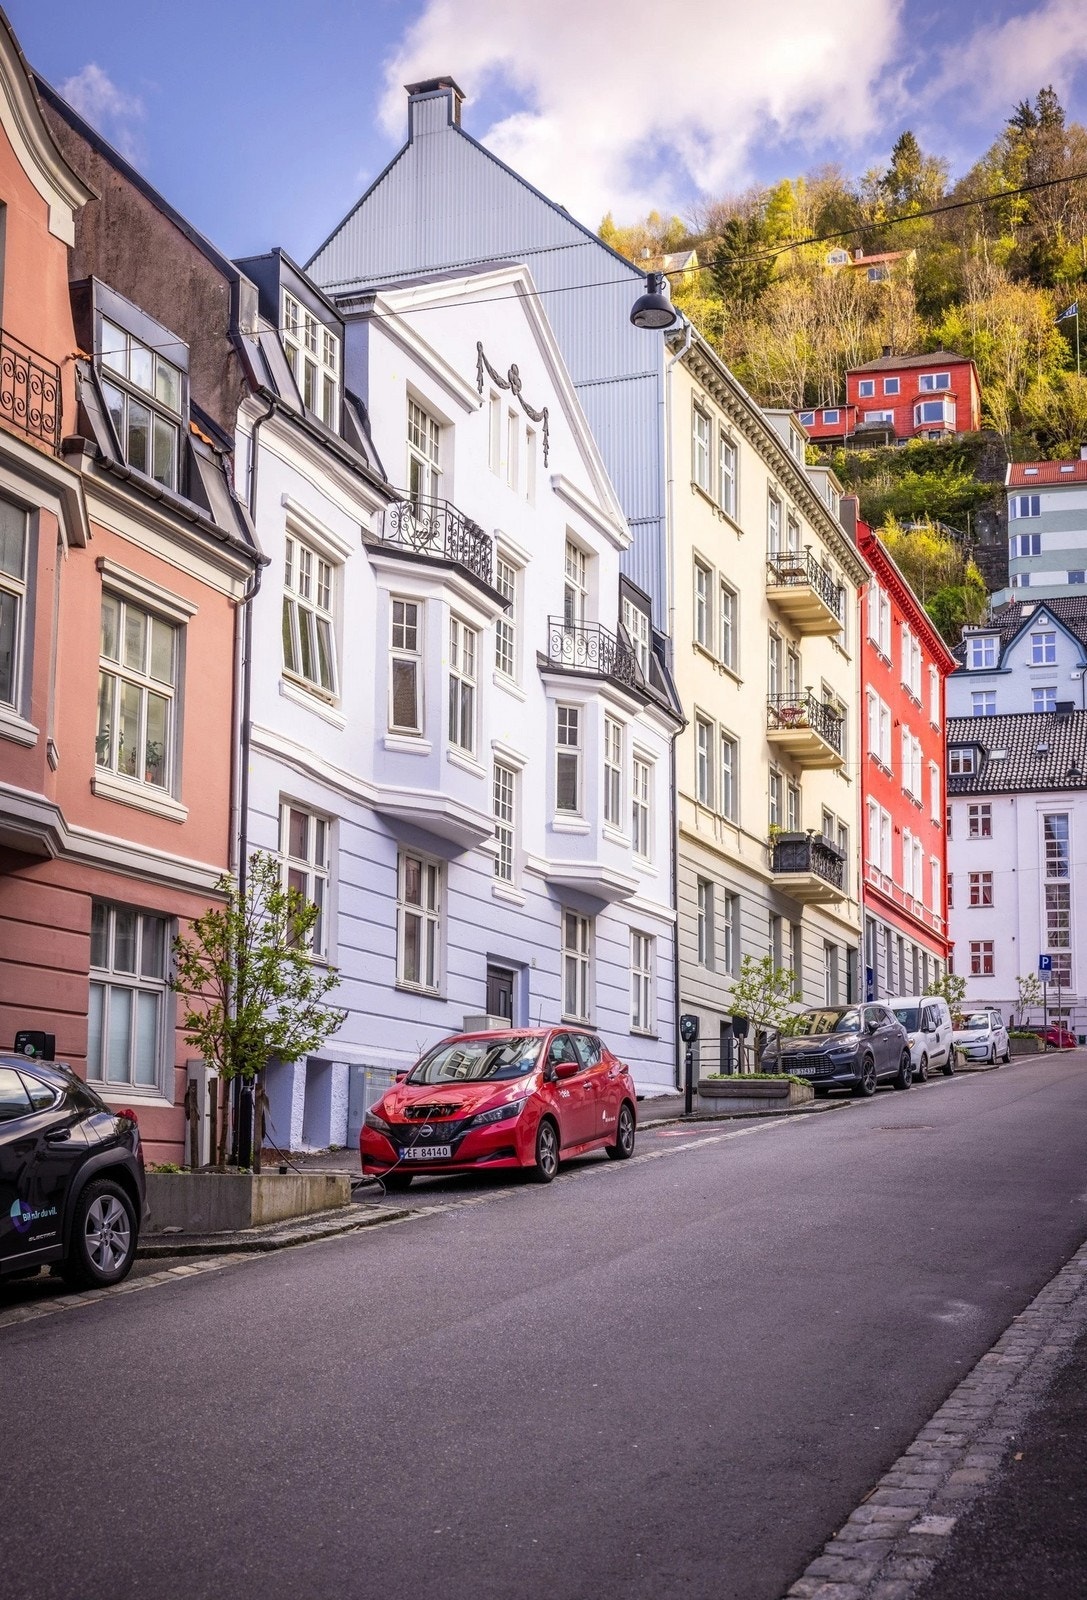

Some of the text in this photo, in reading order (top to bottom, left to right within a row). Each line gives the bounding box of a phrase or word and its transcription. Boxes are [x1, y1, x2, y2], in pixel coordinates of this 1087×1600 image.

[1042, 956, 1049, 969] P
[407, 1147, 448, 1158] EF 84140
[22, 1212, 31, 1222] Bil
[31, 1210, 40, 1220] når
[40, 1209, 48, 1218] du
[28, 1231, 57, 1242] ELECTRIC
